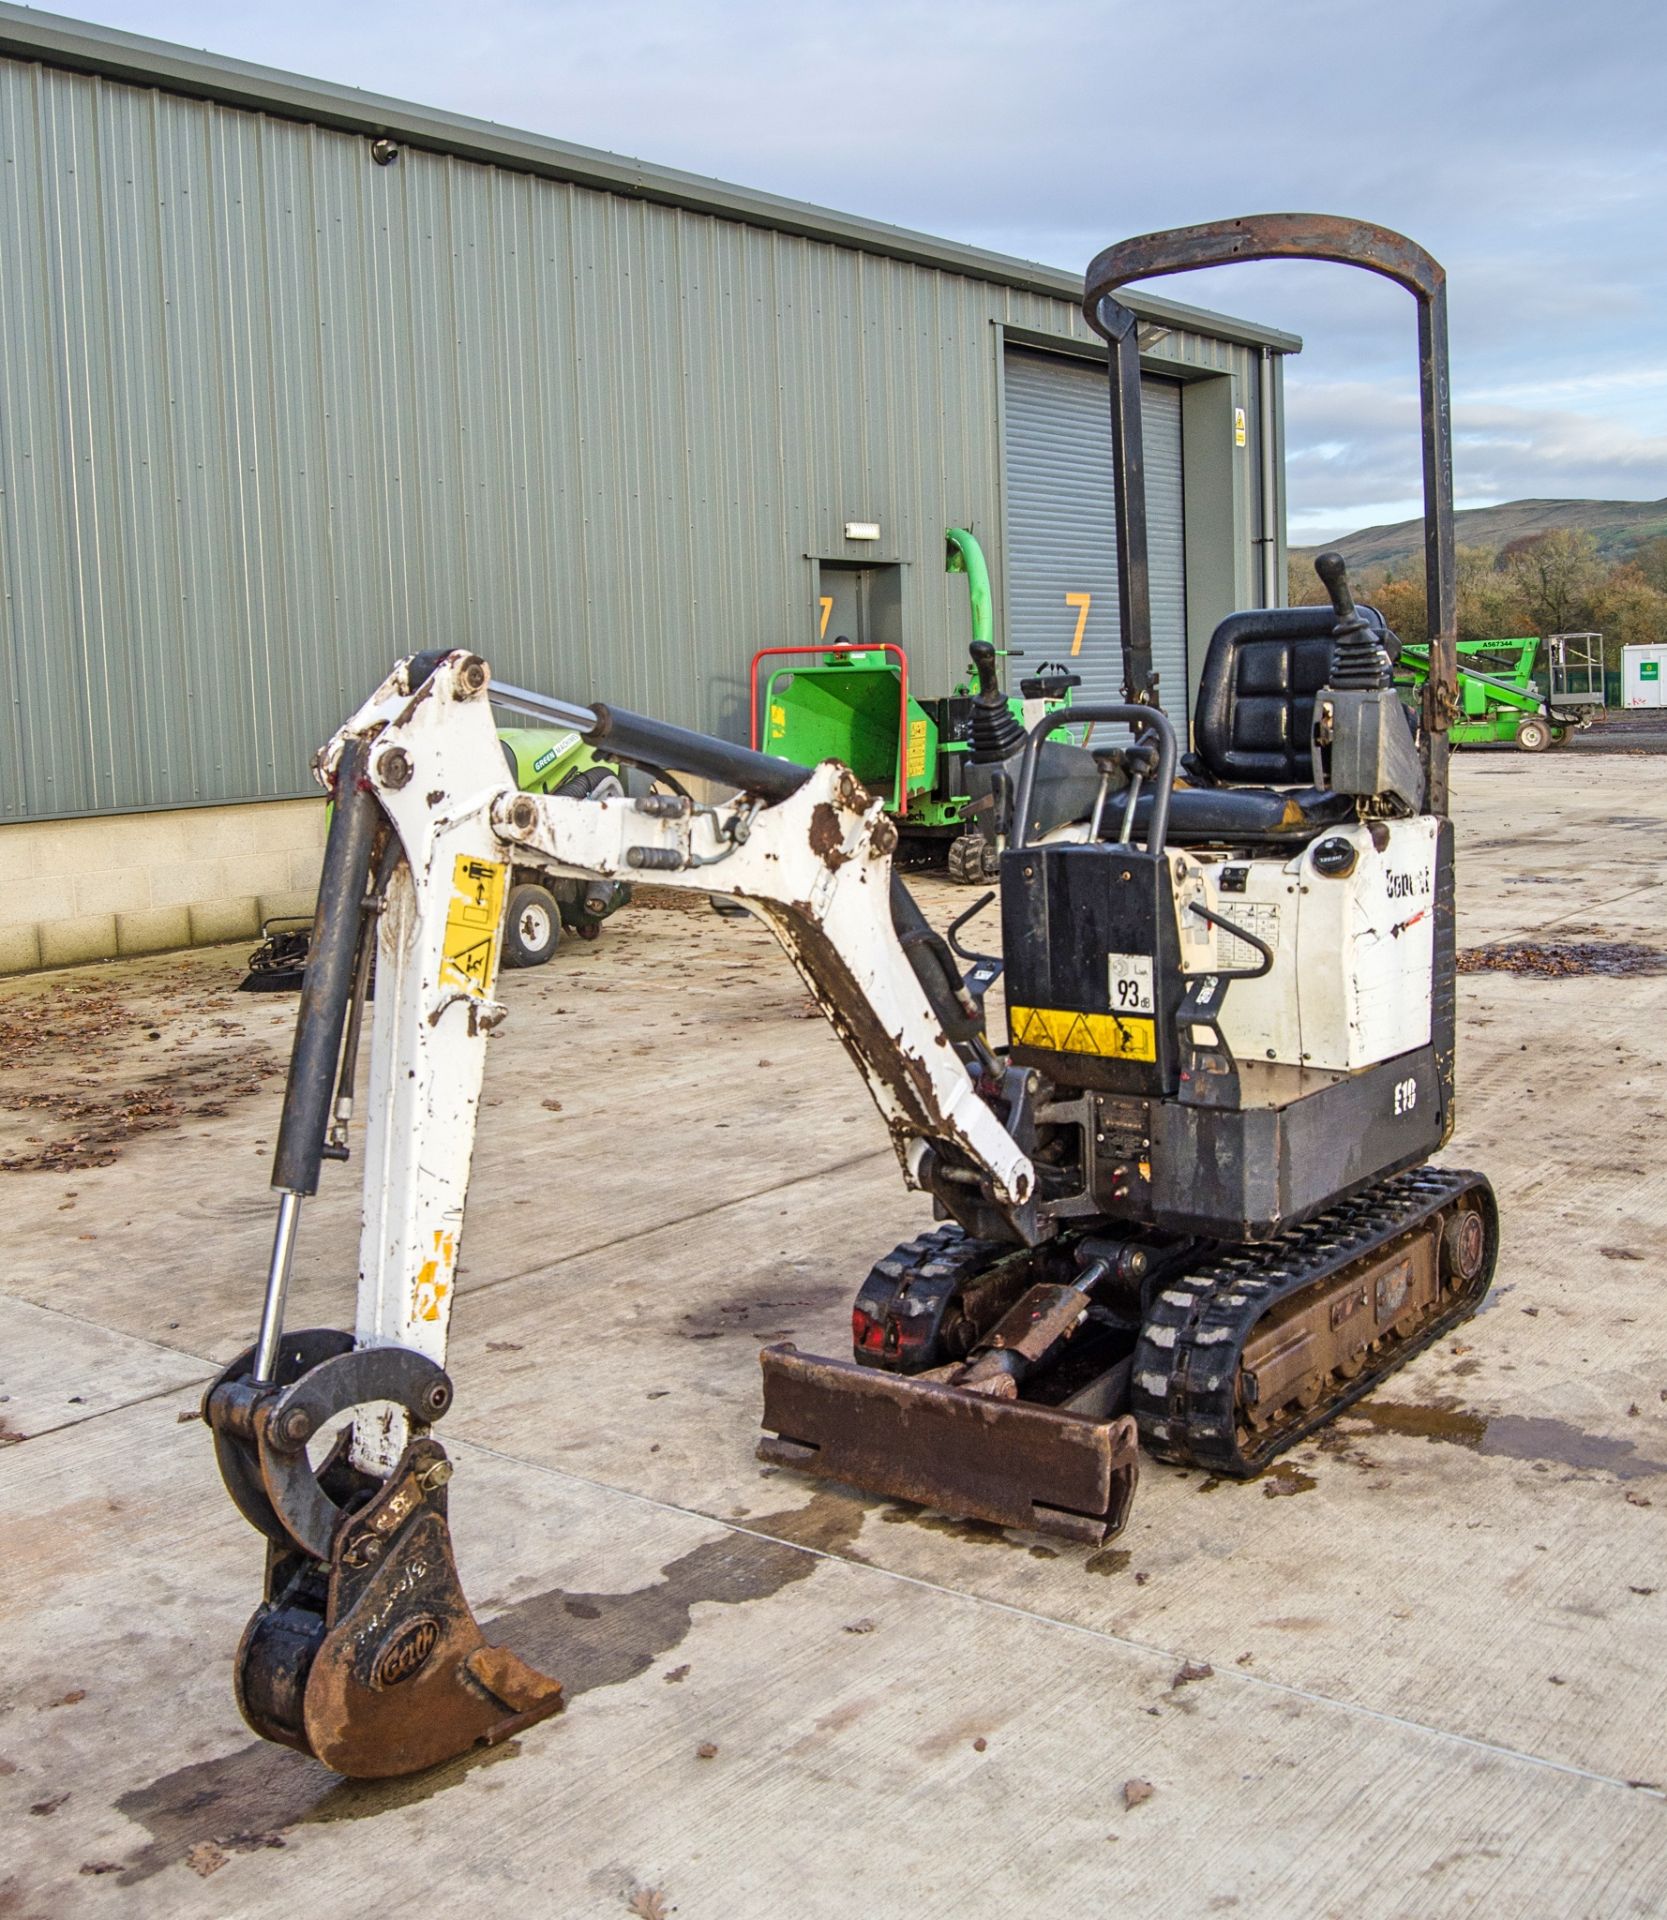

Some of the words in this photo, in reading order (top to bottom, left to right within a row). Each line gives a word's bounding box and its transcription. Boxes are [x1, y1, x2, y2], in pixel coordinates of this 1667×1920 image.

[819, 597, 833, 640] 7
[1066, 592, 1091, 656] 7
[1482, 641, 1513, 649] A567344
[534, 750, 556, 771] GREEN
[1118, 979, 1139, 1008] 93
[1394, 1077, 1417, 1116] E10
